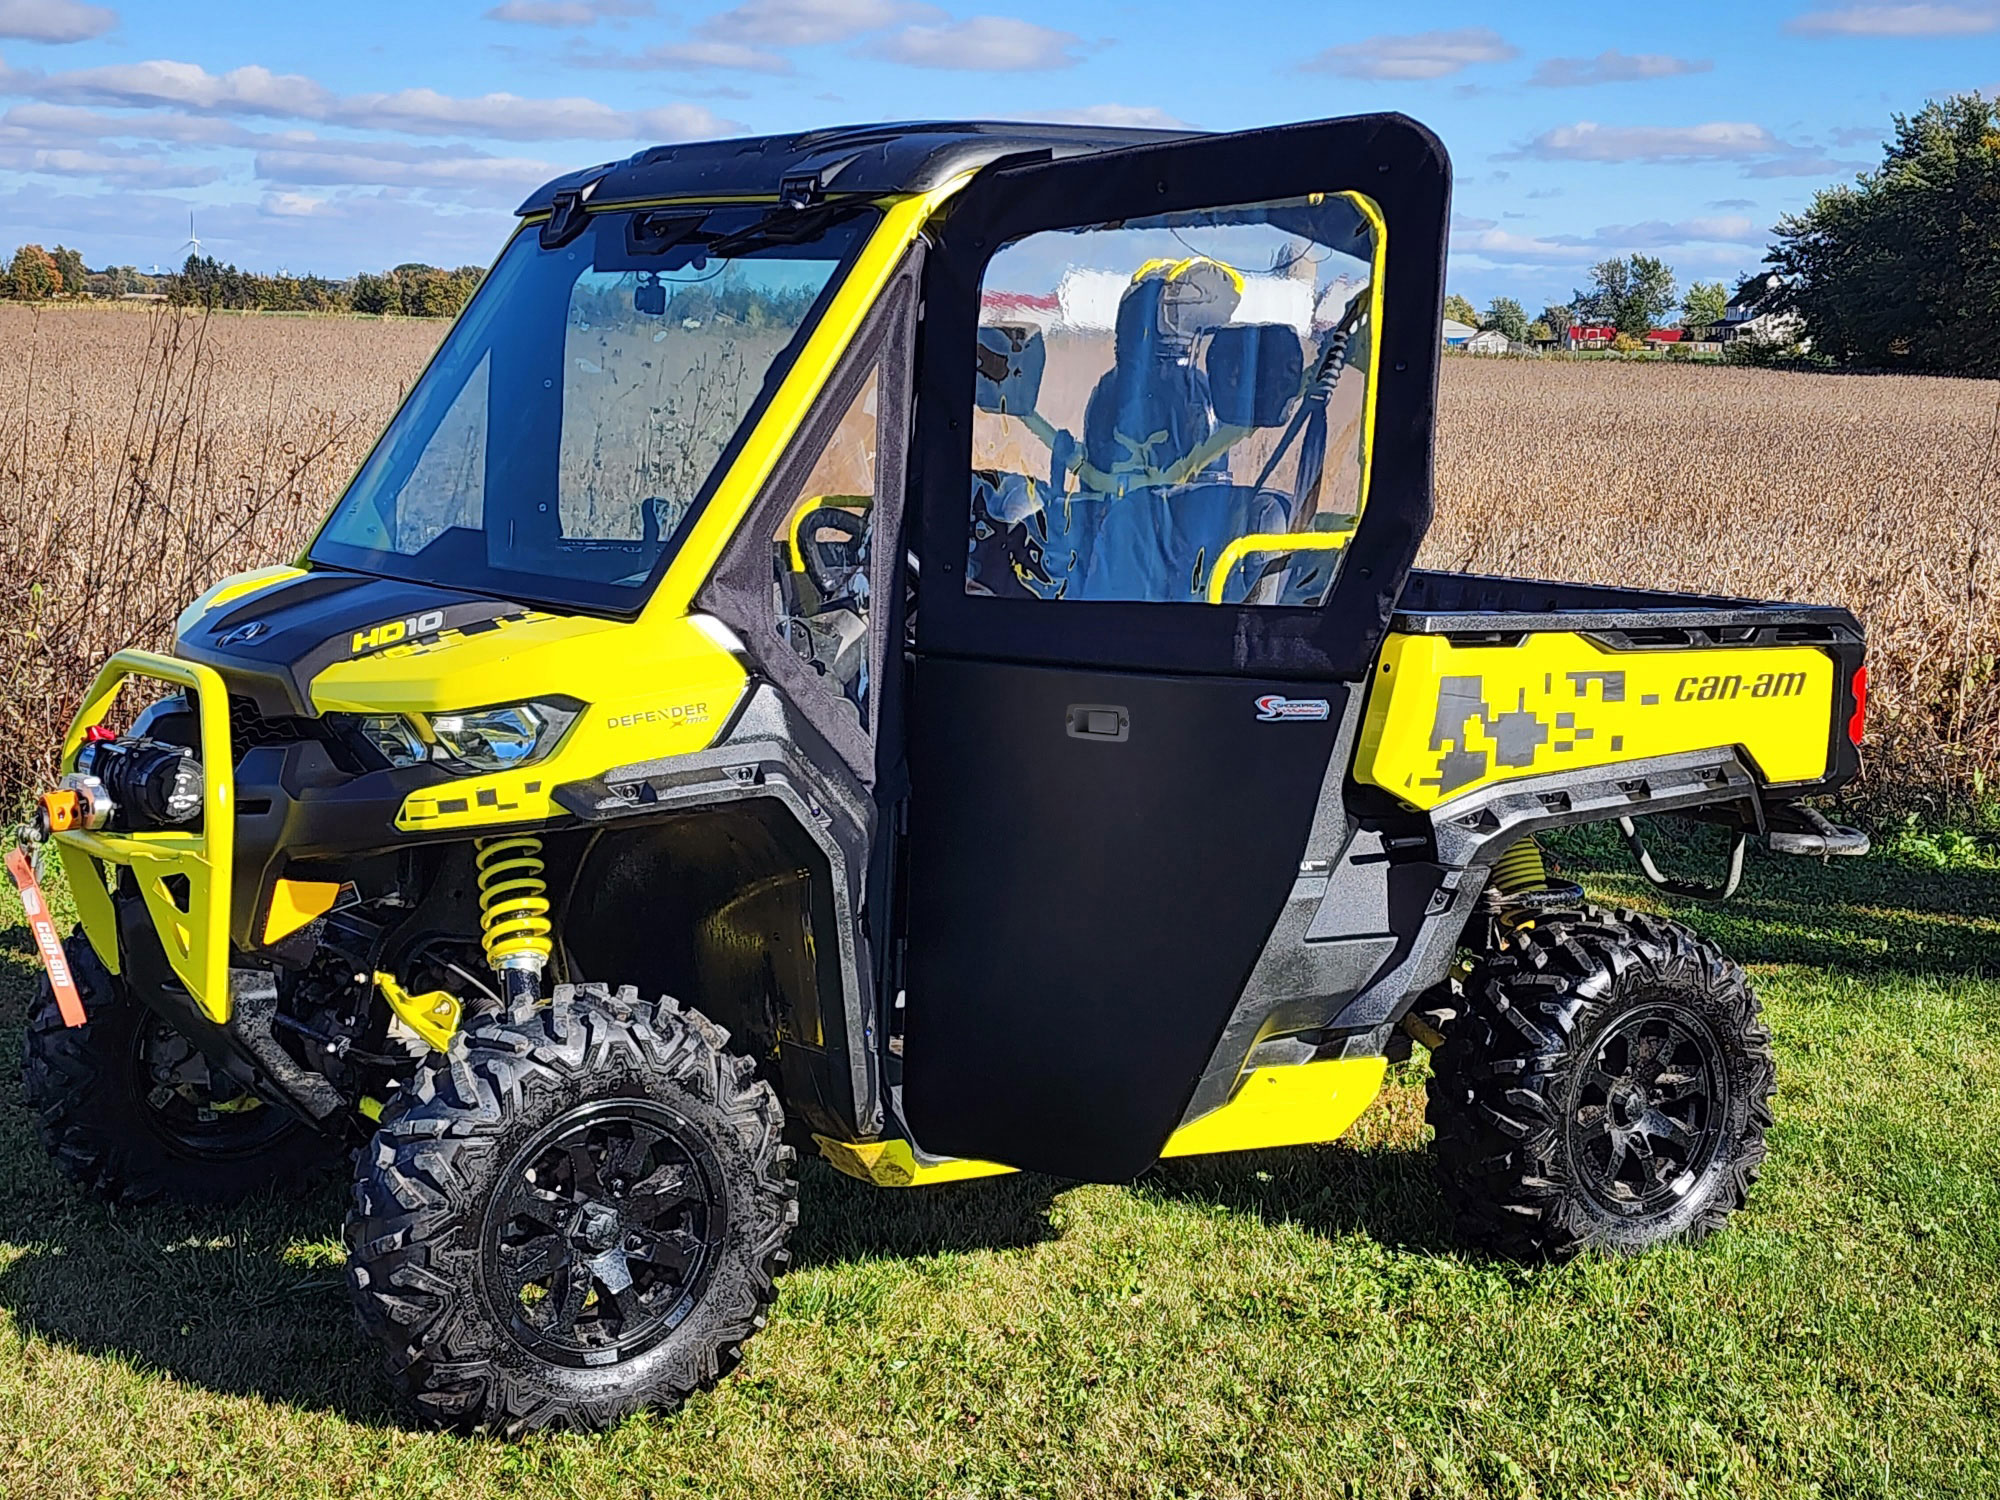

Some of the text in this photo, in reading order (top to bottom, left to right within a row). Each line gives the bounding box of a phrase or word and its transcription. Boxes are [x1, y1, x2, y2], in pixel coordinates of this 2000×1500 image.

[352, 611, 443, 653] HD10
[1674, 671, 1807, 702] can-am
[607, 702, 708, 729] DEFENDER
[35, 921, 70, 987] can-am
